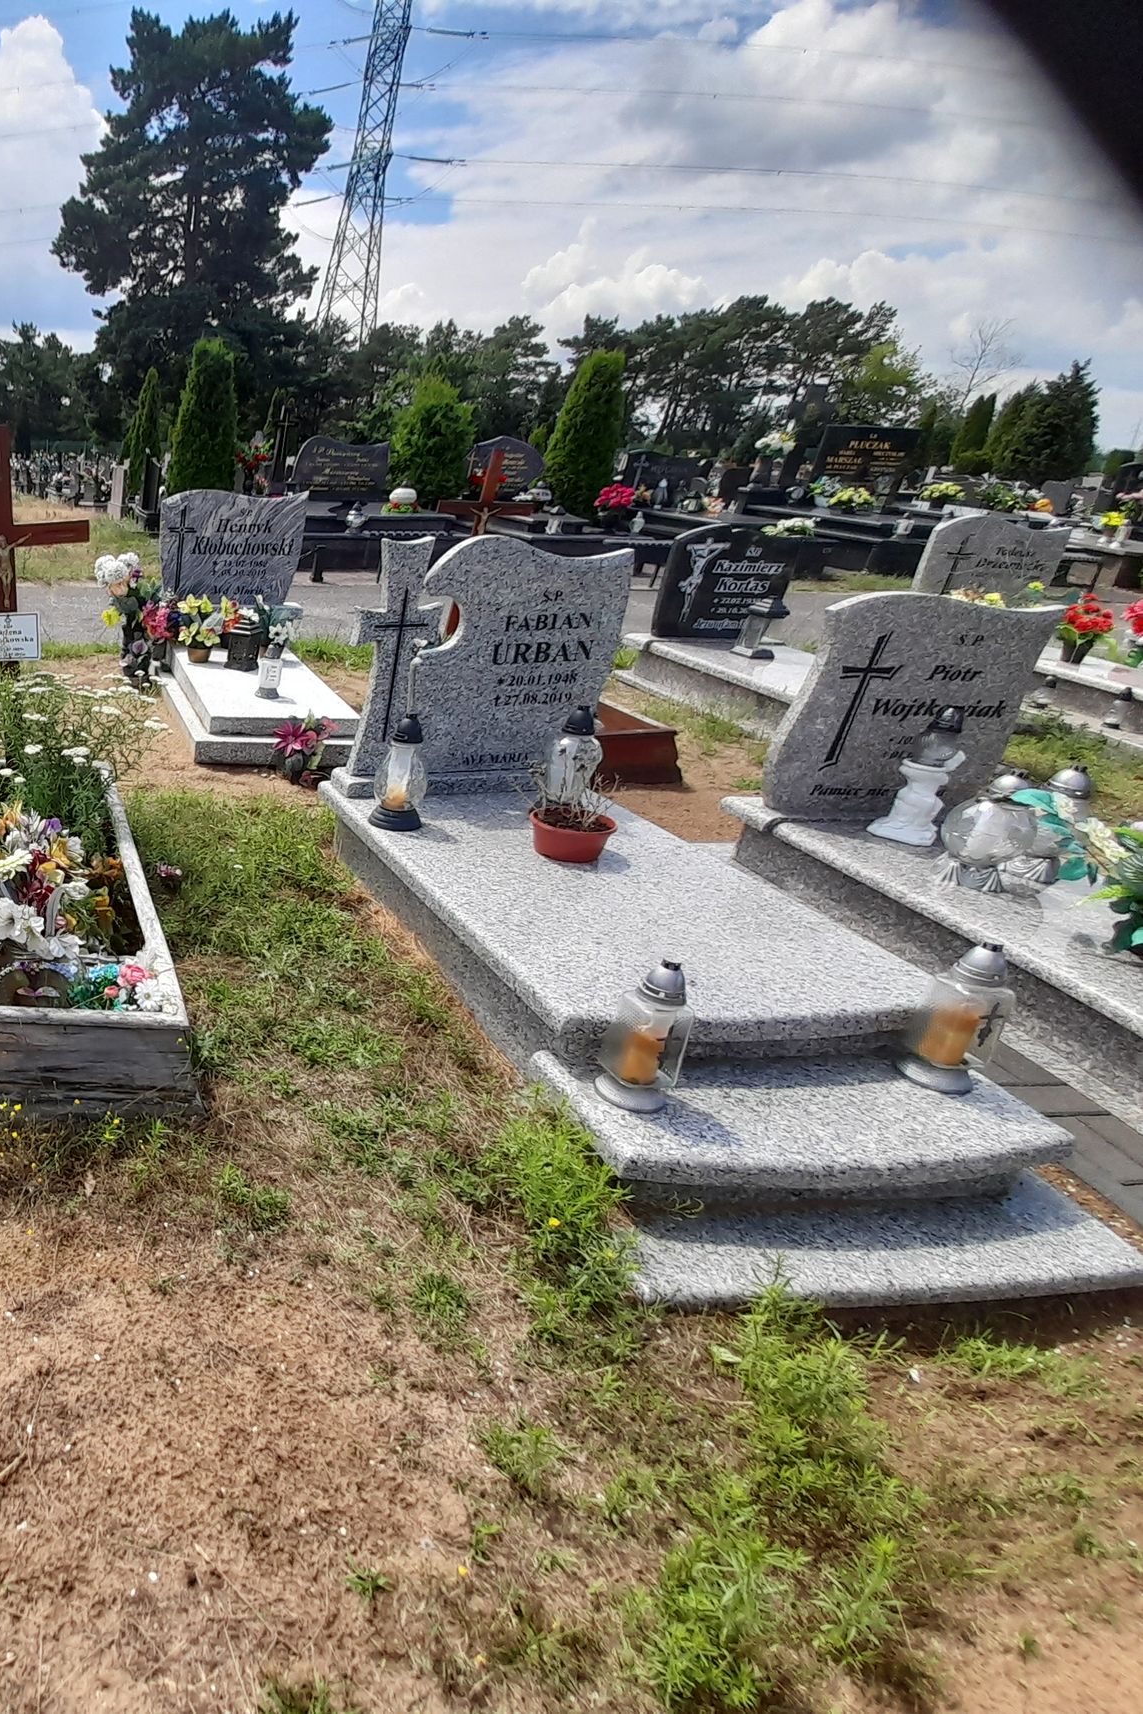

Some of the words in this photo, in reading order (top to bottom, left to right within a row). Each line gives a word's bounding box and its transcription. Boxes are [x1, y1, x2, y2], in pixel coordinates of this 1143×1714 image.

[215, 518, 272, 537] Henryk
[191, 535, 294, 556] Kłobuchowski
[712, 560, 786, 574] Kazimierz
[714, 577, 770, 594] Kortas
[504, 612, 594, 632] FABIAN
[492, 640, 594, 666] URBAN
[925, 665, 983, 681] Piotr
[871, 698, 1007, 722] Wojtkiak
